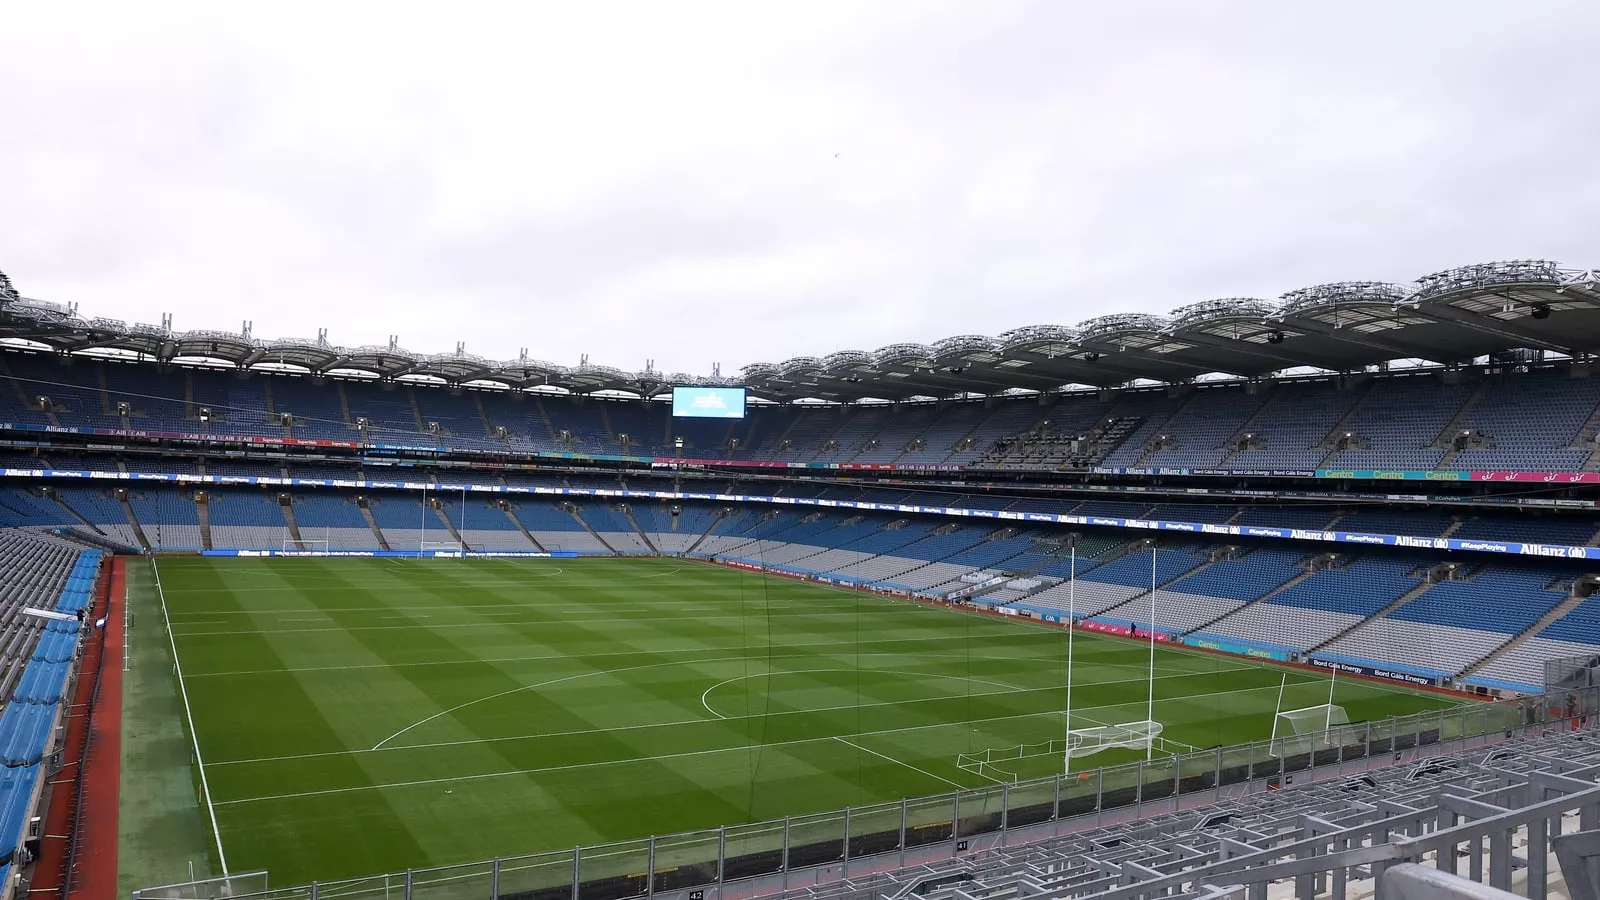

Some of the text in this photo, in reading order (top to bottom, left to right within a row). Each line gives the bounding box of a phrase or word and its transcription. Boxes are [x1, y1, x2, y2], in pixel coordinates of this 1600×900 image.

[1374, 471, 1404, 479] Centra
[1426, 471, 1458, 480] Centra
[1202, 525, 1228, 534] Allianz
[1249, 529, 1281, 537] #KeepPlaying
[1290, 529, 1322, 540] Allianz
[1346, 535, 1384, 544] #KeepPlaying
[1395, 536, 1431, 547] Allianz
[1461, 543, 1506, 552] #KeepPlaying
[1520, 544, 1566, 557] Allianz
[1198, 640, 1219, 649] Centra
[1248, 649, 1271, 657] Centra
[1342, 663, 1362, 674] Energy
[1406, 673, 1429, 684] Energy
